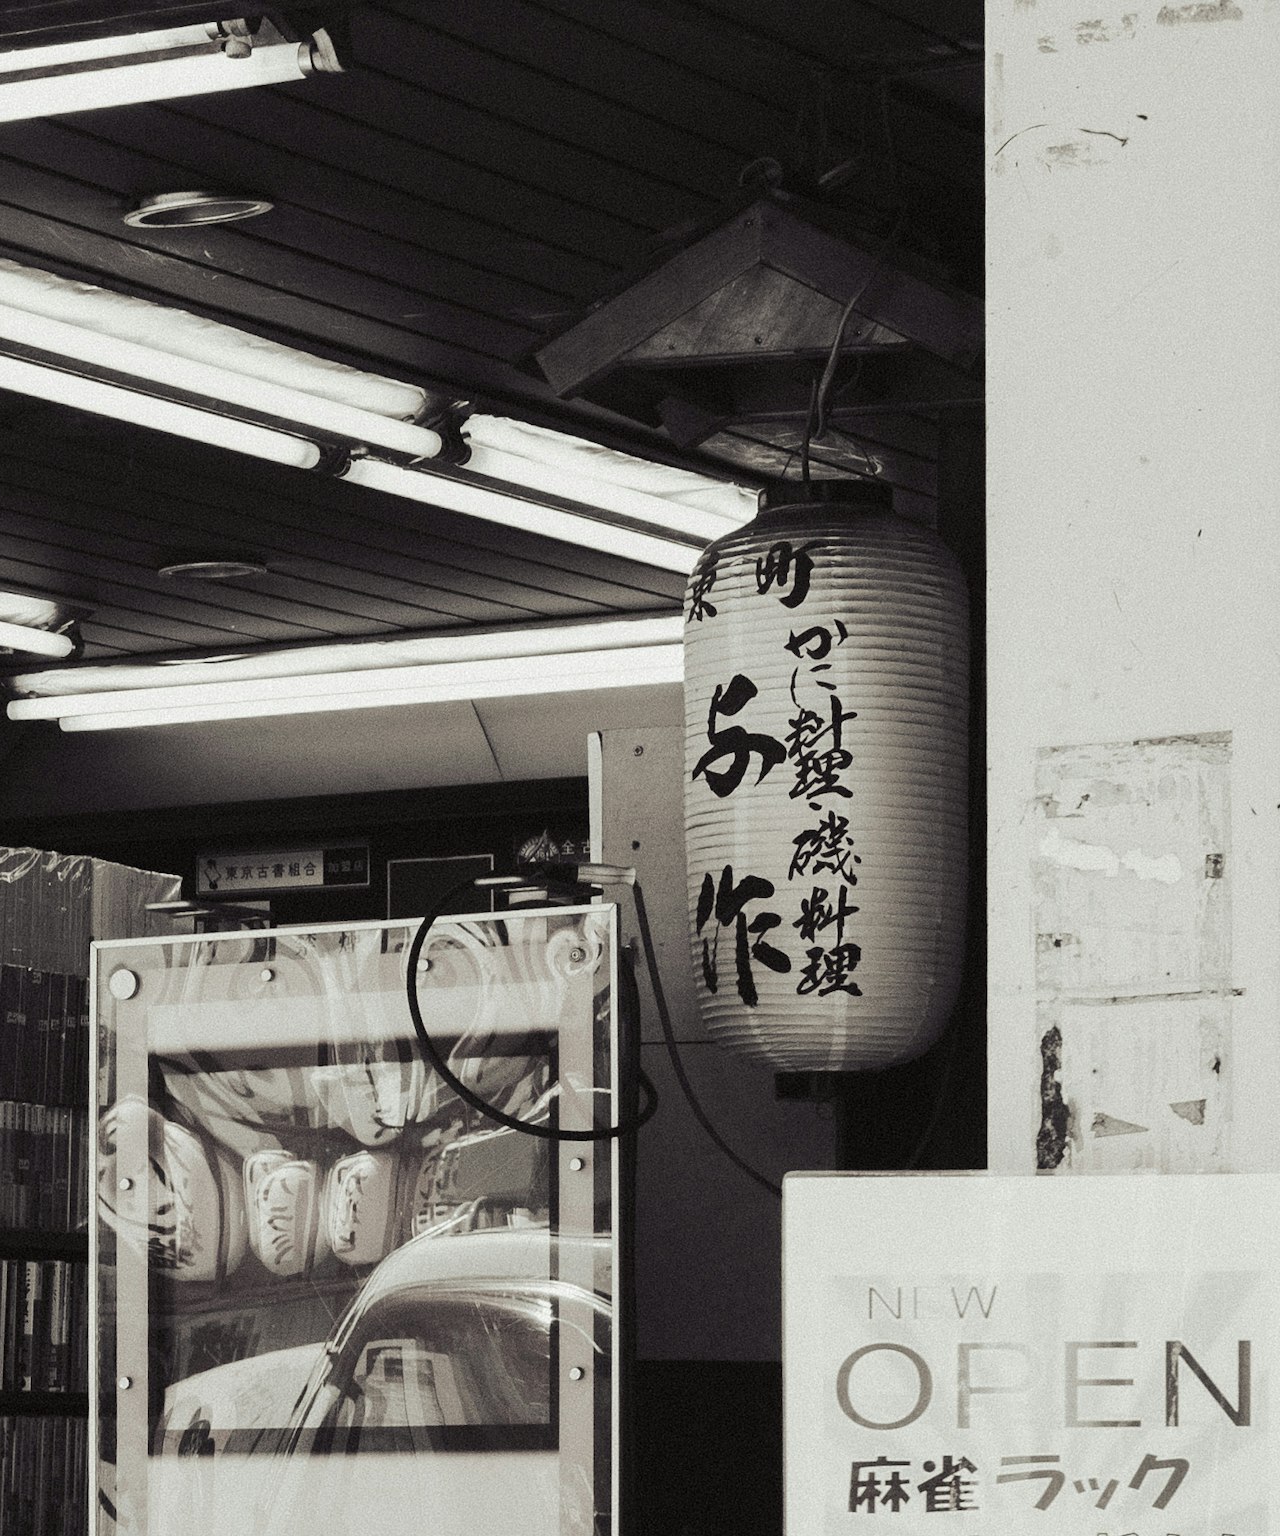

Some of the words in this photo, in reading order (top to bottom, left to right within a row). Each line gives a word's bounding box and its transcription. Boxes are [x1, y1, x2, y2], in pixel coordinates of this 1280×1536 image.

[225, 861, 316, 880] 東京古書組合
[836, 1340, 1251, 1430] OPEN
[848, 1454, 1189, 1513] 麻雀ラック
